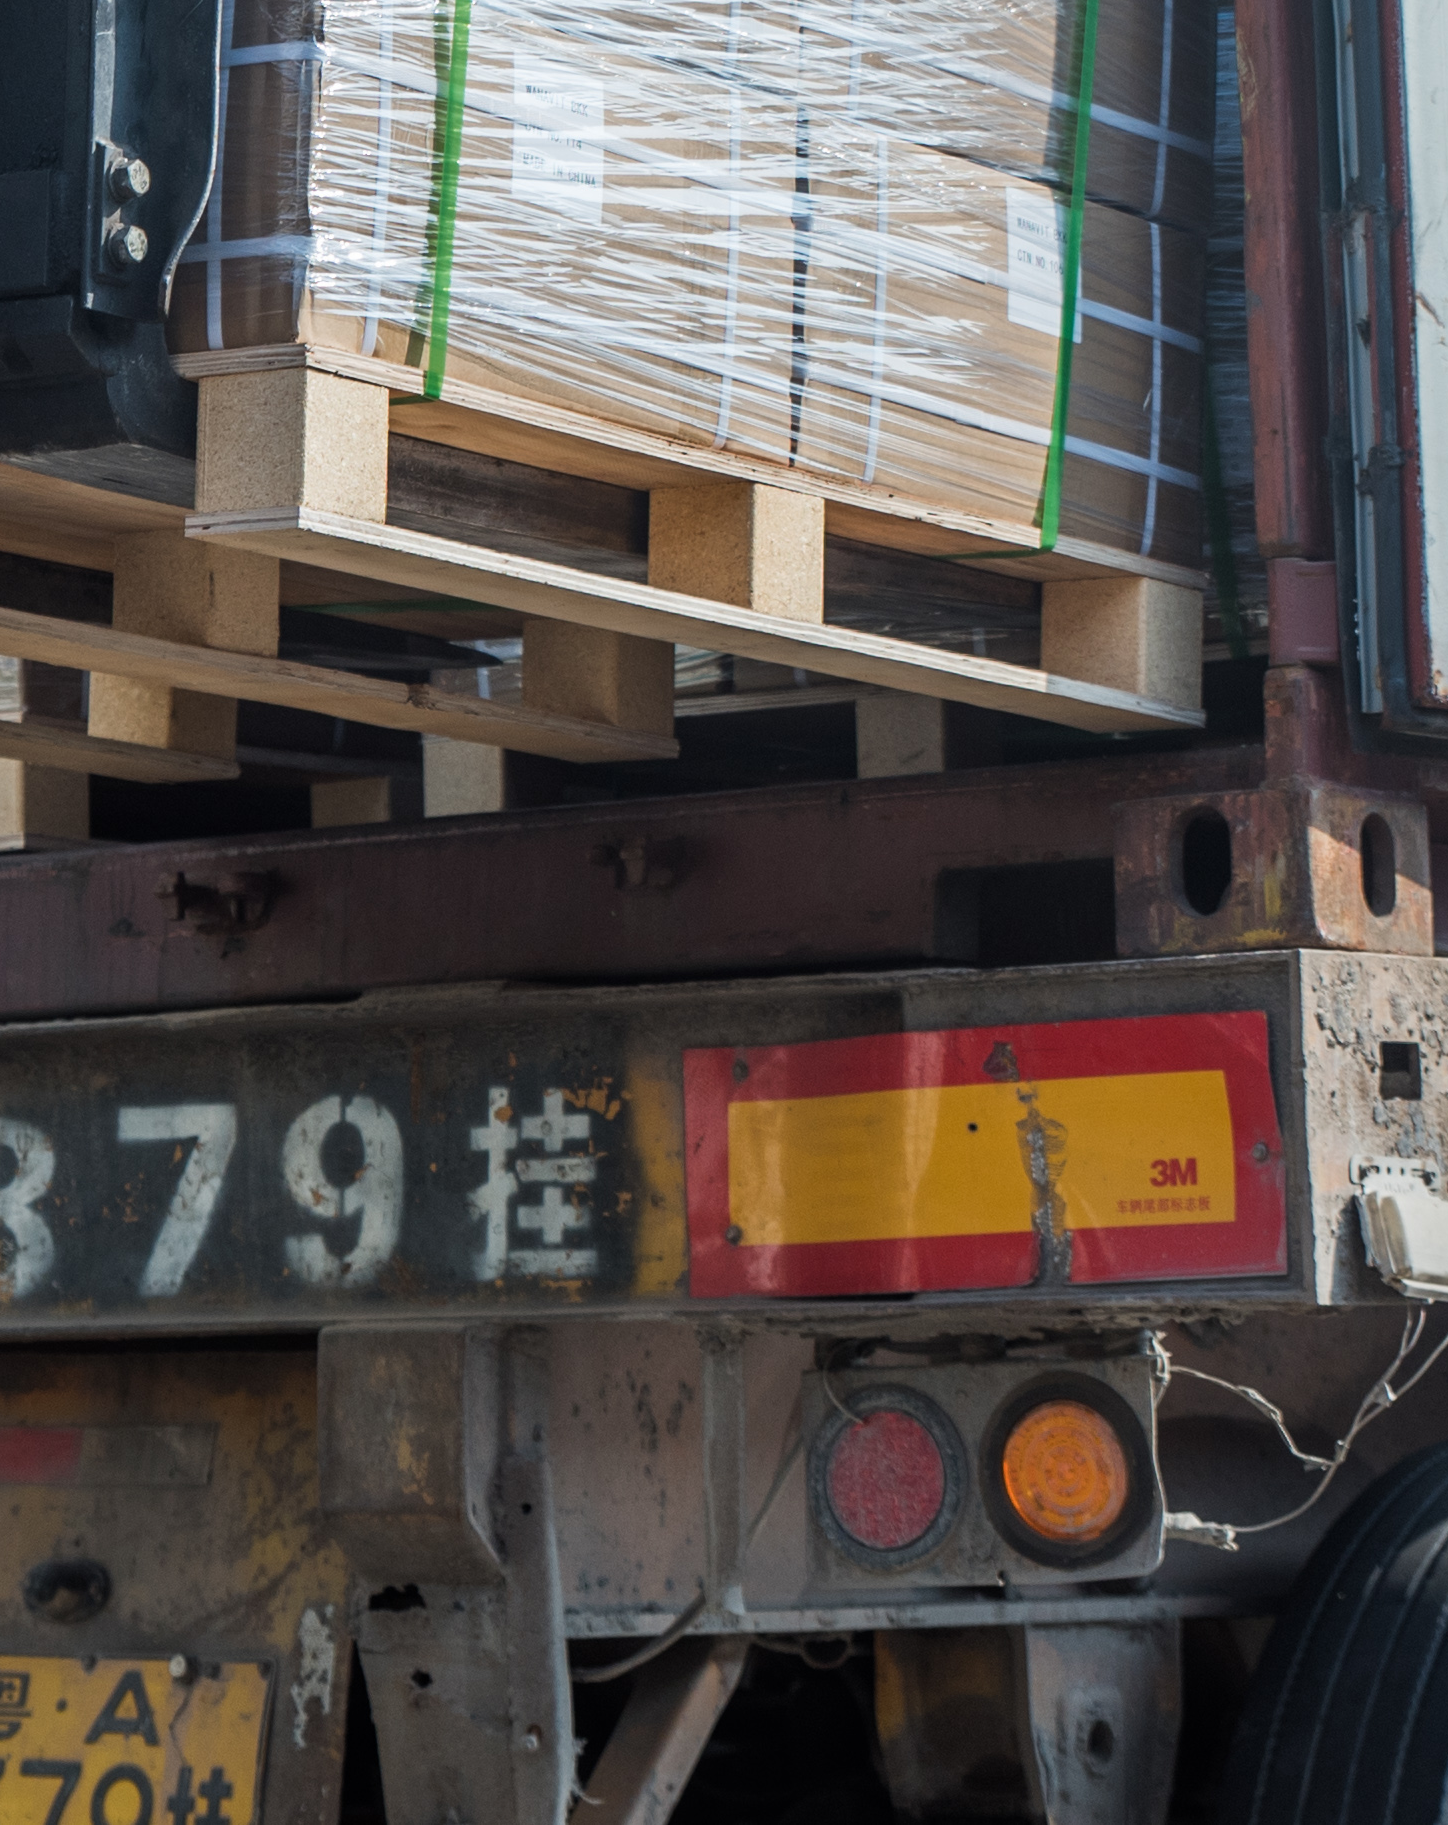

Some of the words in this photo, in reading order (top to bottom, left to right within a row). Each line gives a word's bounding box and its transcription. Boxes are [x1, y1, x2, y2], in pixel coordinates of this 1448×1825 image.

[569, 171, 596, 186] CHINA
[1017, 249, 1032, 265] CTN
[1150, 1158, 1198, 1187] 3M
